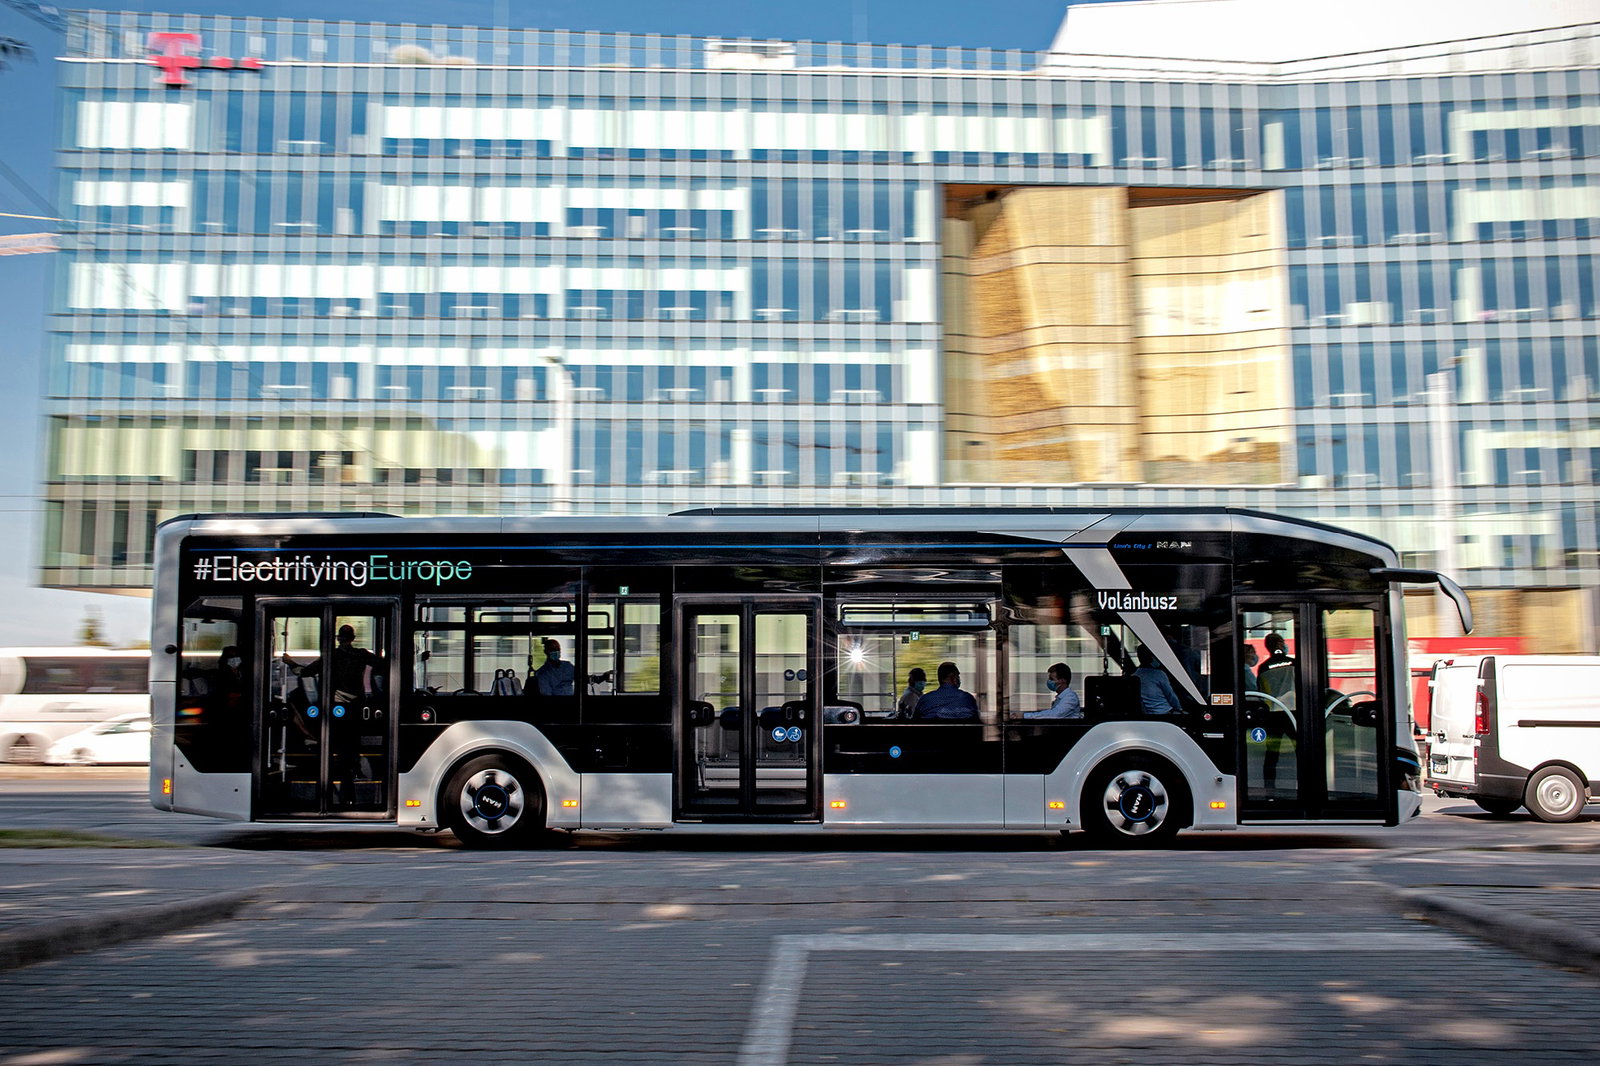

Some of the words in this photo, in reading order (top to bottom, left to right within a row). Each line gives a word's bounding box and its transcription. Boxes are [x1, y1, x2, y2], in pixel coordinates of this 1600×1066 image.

[1156, 541, 1192, 549] MAN
[193, 555, 472, 587] #ElectrifyingEurope
[1098, 591, 1178, 610] Volánbusz
[482, 795, 502, 809] MAN
